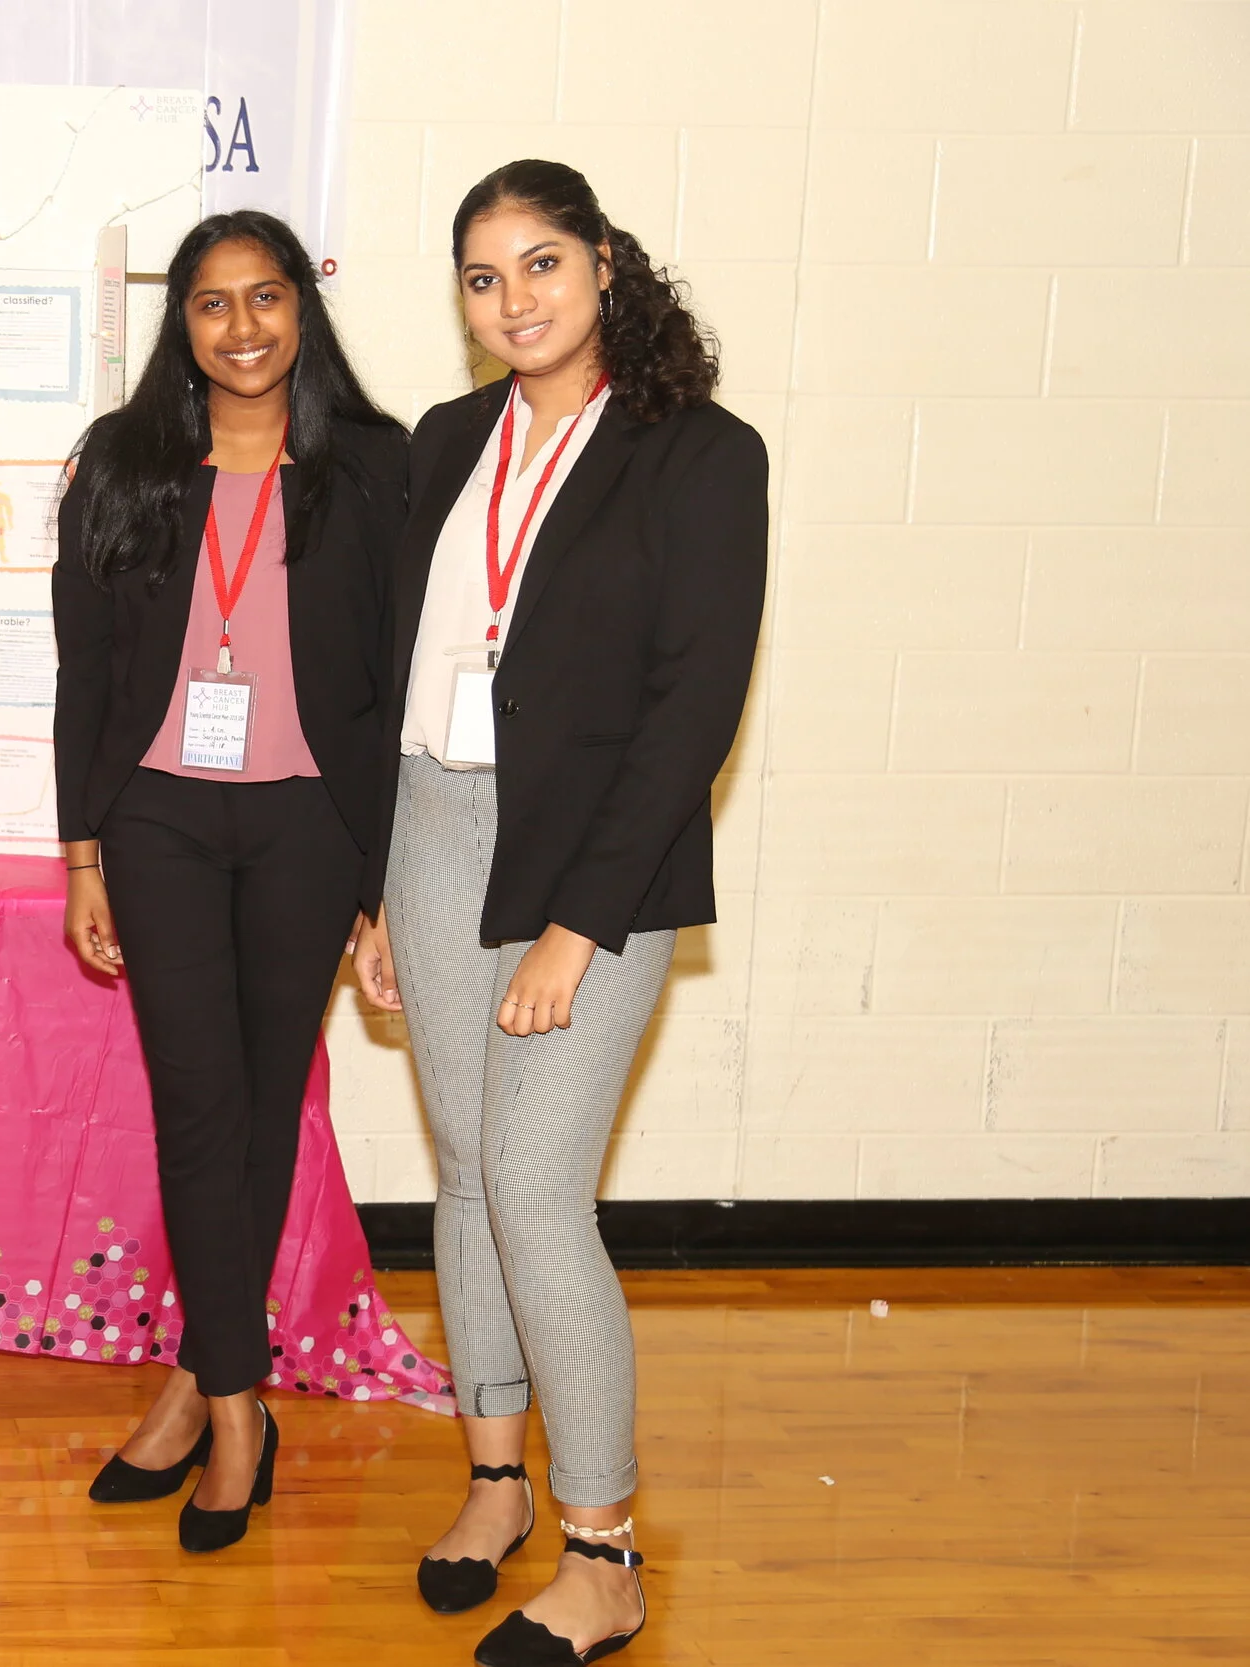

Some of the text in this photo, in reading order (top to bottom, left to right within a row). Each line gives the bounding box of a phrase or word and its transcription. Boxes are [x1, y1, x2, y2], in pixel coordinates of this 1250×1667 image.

[156, 96, 195, 105] BREAST
[156, 105, 198, 114] CANCER
[156, 114, 178, 123] HUB
[3, 296, 54, 306] classified?
[213, 688, 243, 697] BREAST
[212, 696, 245, 705] CANCER
[212, 704, 229, 712] HUB
[188, 753, 238, 766] PARTICIPANT
